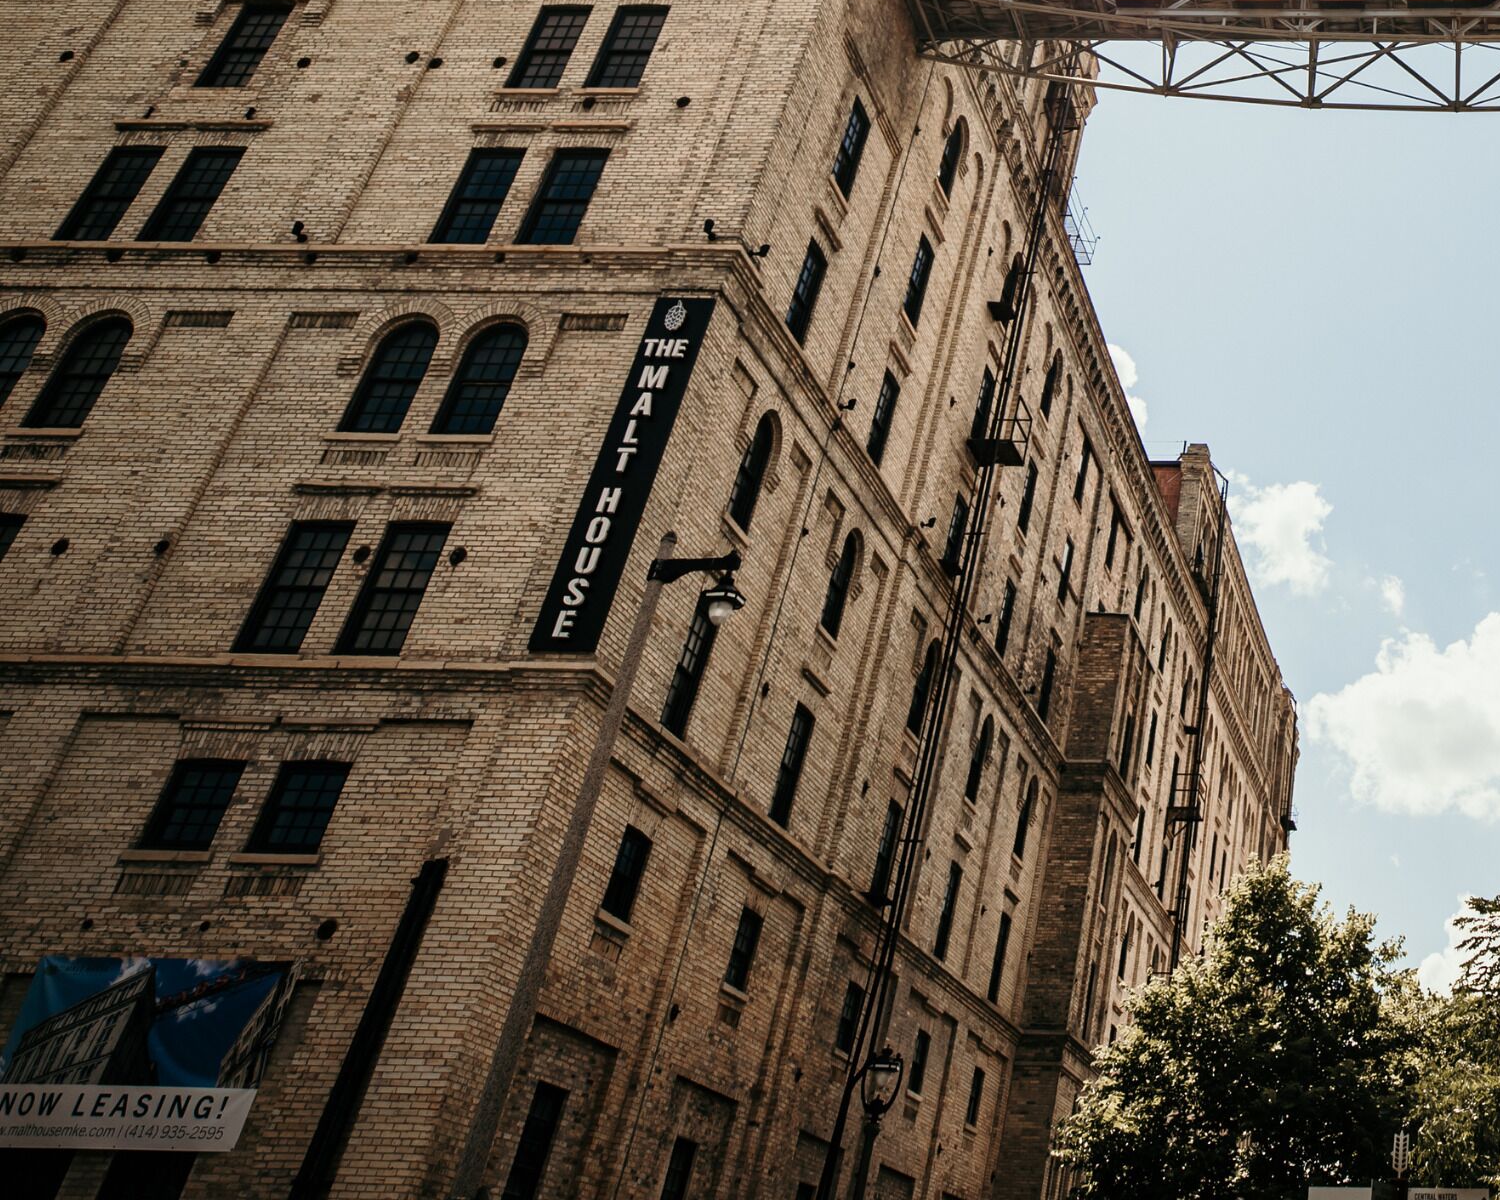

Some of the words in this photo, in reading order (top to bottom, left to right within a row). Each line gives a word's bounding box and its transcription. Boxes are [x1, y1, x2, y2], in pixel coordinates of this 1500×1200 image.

[644, 339, 689, 359] THE
[614, 365, 670, 473] MALT
[551, 487, 622, 638] HOUSE
[0, 1091, 63, 1116] NOW
[71, 1092, 229, 1119] LEASING!
[124, 1124, 159, 1139] (414)
[159, 1125, 225, 1140] 935-2595
